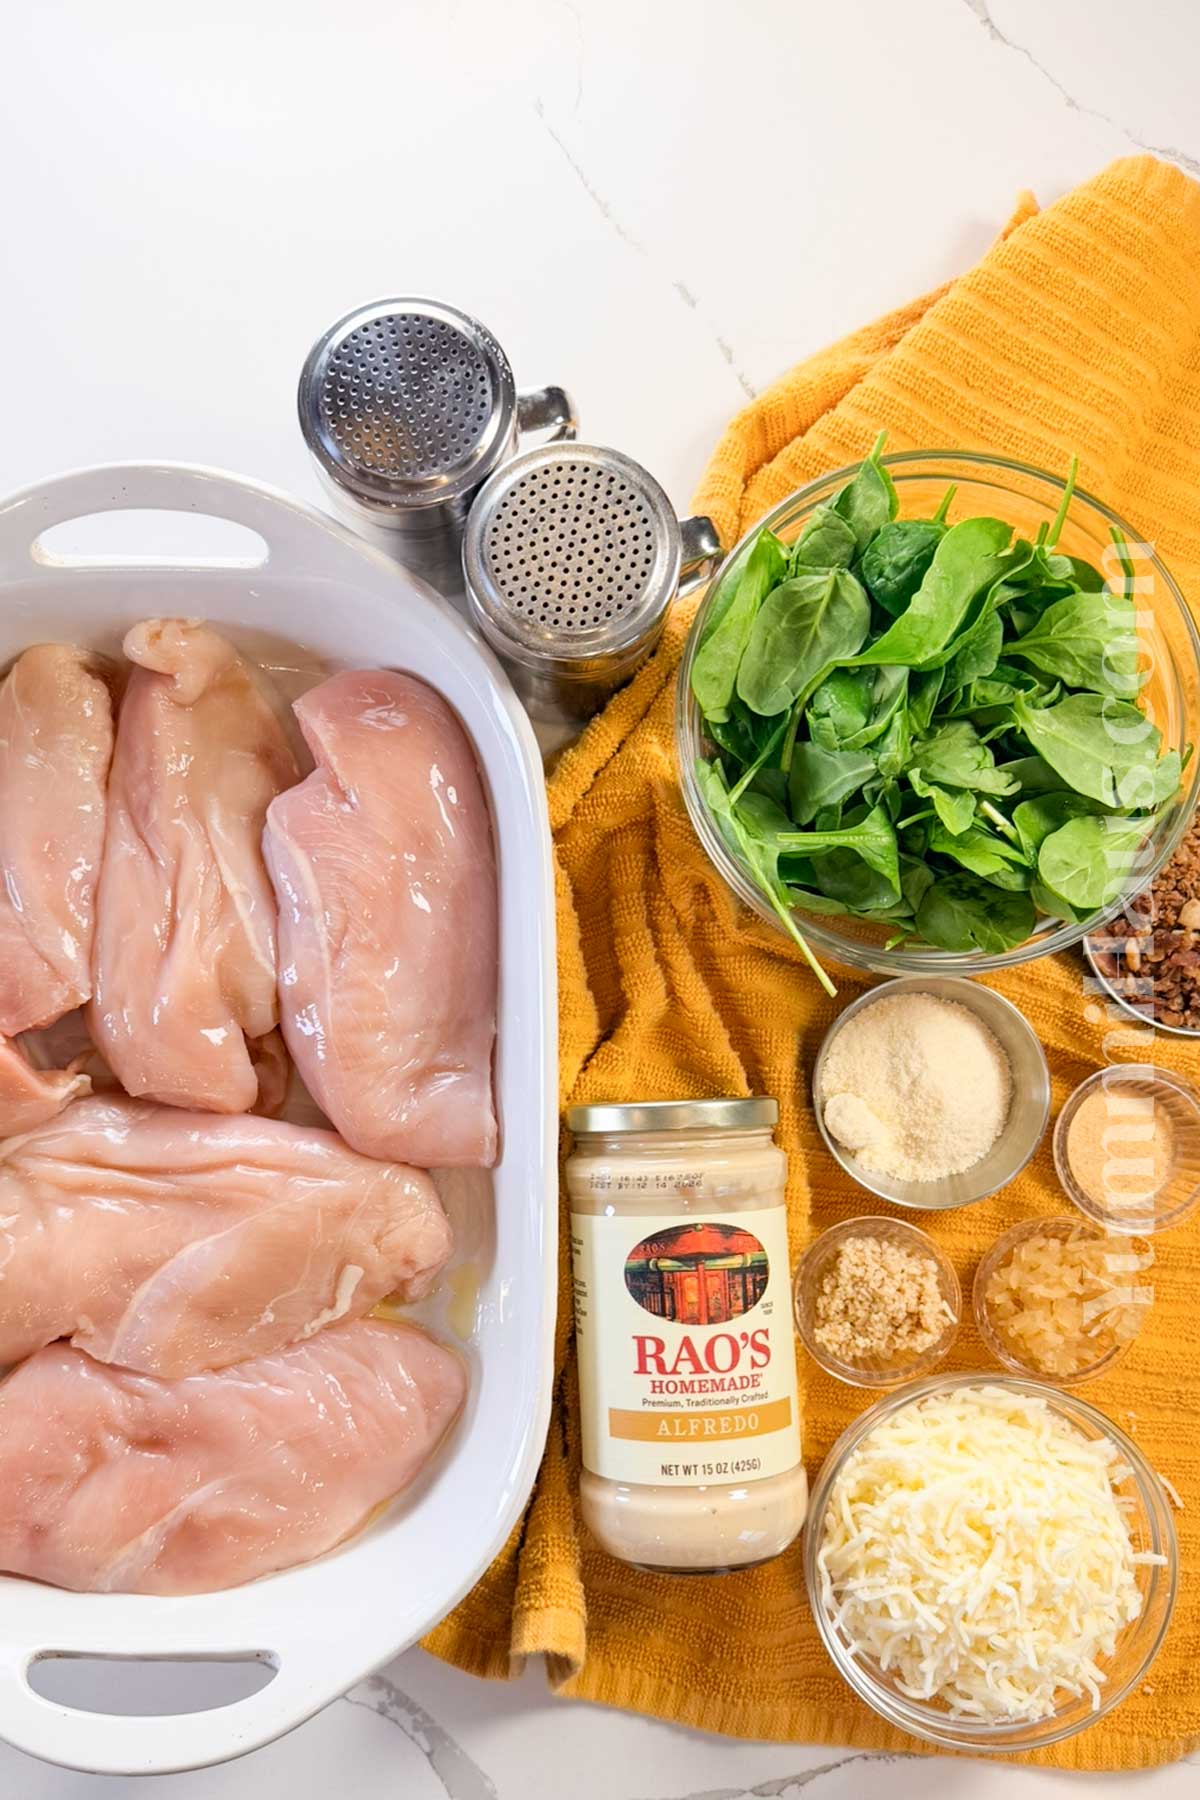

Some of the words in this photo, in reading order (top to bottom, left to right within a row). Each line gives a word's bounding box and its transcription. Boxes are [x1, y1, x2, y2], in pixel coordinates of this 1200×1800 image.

[632, 1328, 771, 1375] RAO'S
[650, 1374, 761, 1394] HOMEMADE
[642, 1397, 684, 1409] Premium,
[686, 1394, 740, 1408] Traditionally
[740, 1391, 769, 1404] Crafted
[656, 1412, 760, 1437] ALFREDO
[660, 1464, 679, 1477] NET
[682, 1464, 699, 1477] WT
[702, 1464, 713, 1476] 15
[716, 1462, 729, 1475] OZ
[731, 1457, 762, 1475] (425G)
